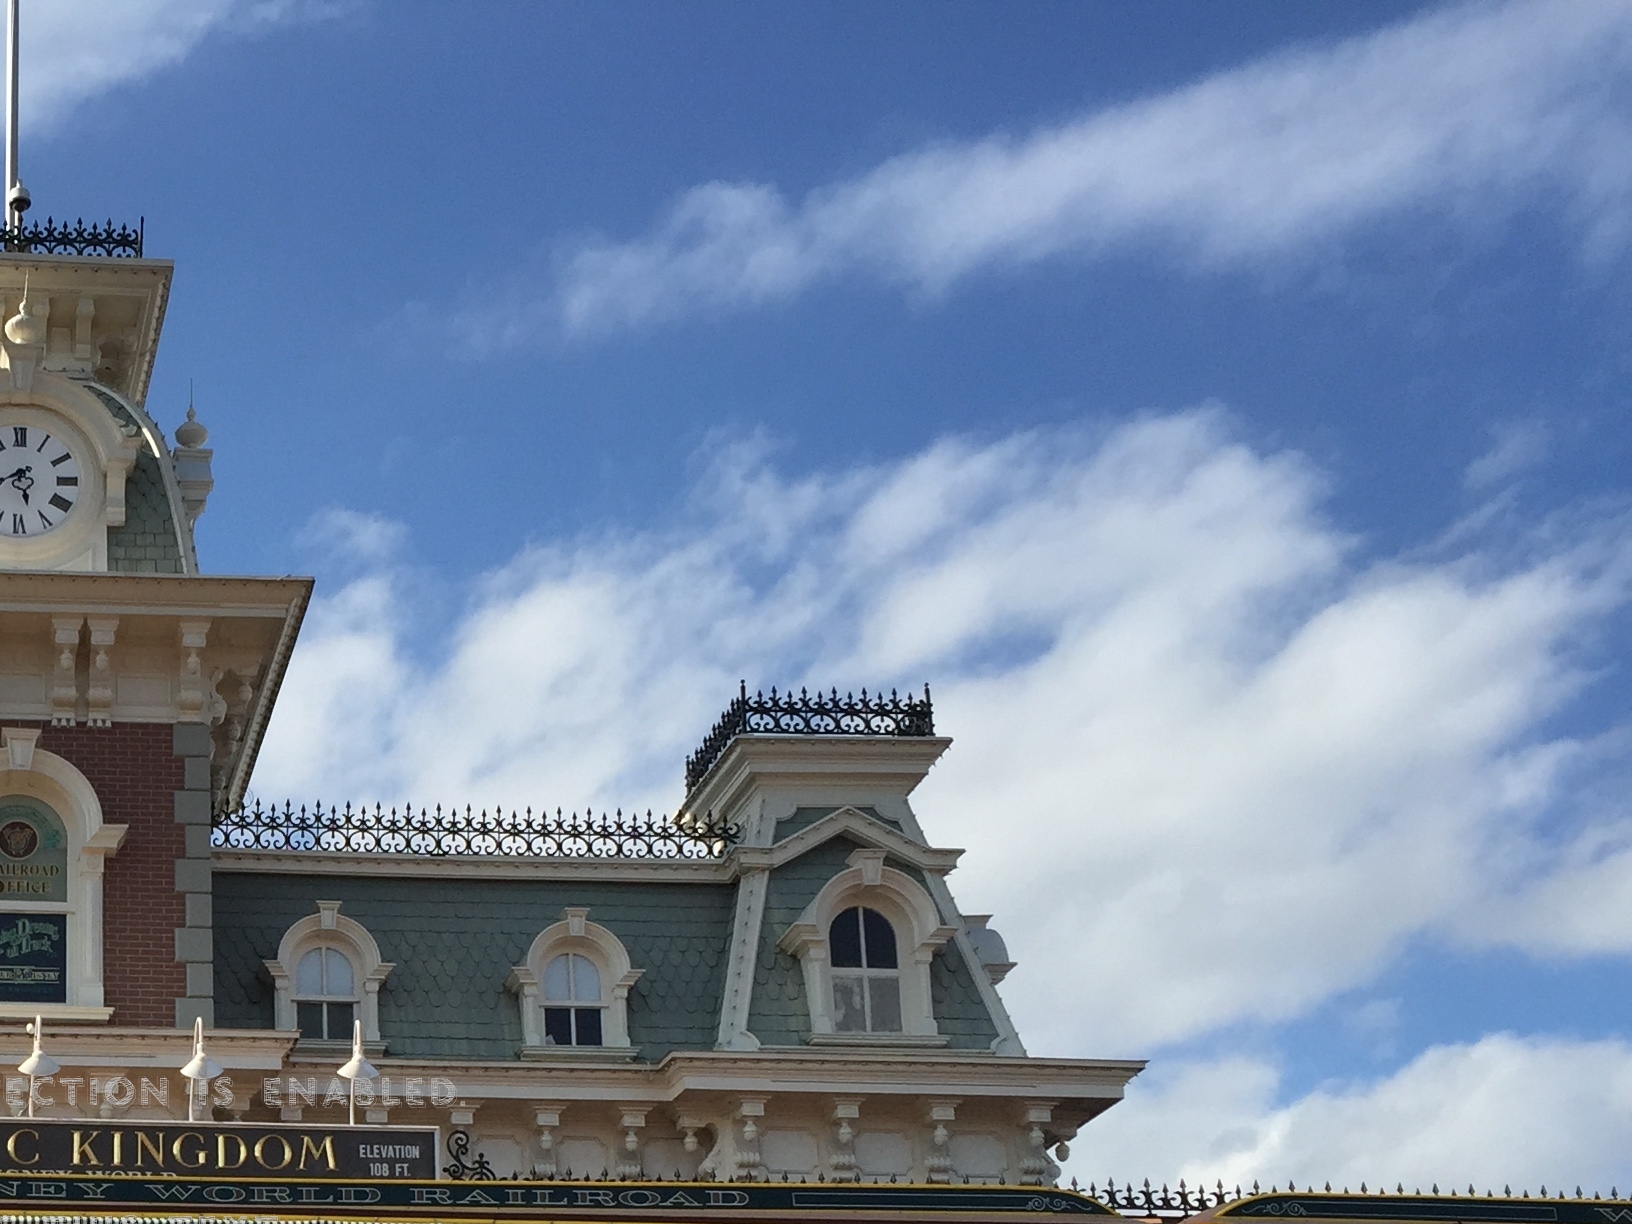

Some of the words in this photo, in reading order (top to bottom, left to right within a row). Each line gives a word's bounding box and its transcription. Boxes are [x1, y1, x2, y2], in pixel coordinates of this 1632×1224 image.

[70, 1130, 339, 1171] KINGDOM
[359, 1144, 420, 1159] ELEVATION
[369, 1162, 389, 1177] 108
[145, 1183, 382, 1204] WORLD
[409, 1187, 750, 1207] RAILROAD
